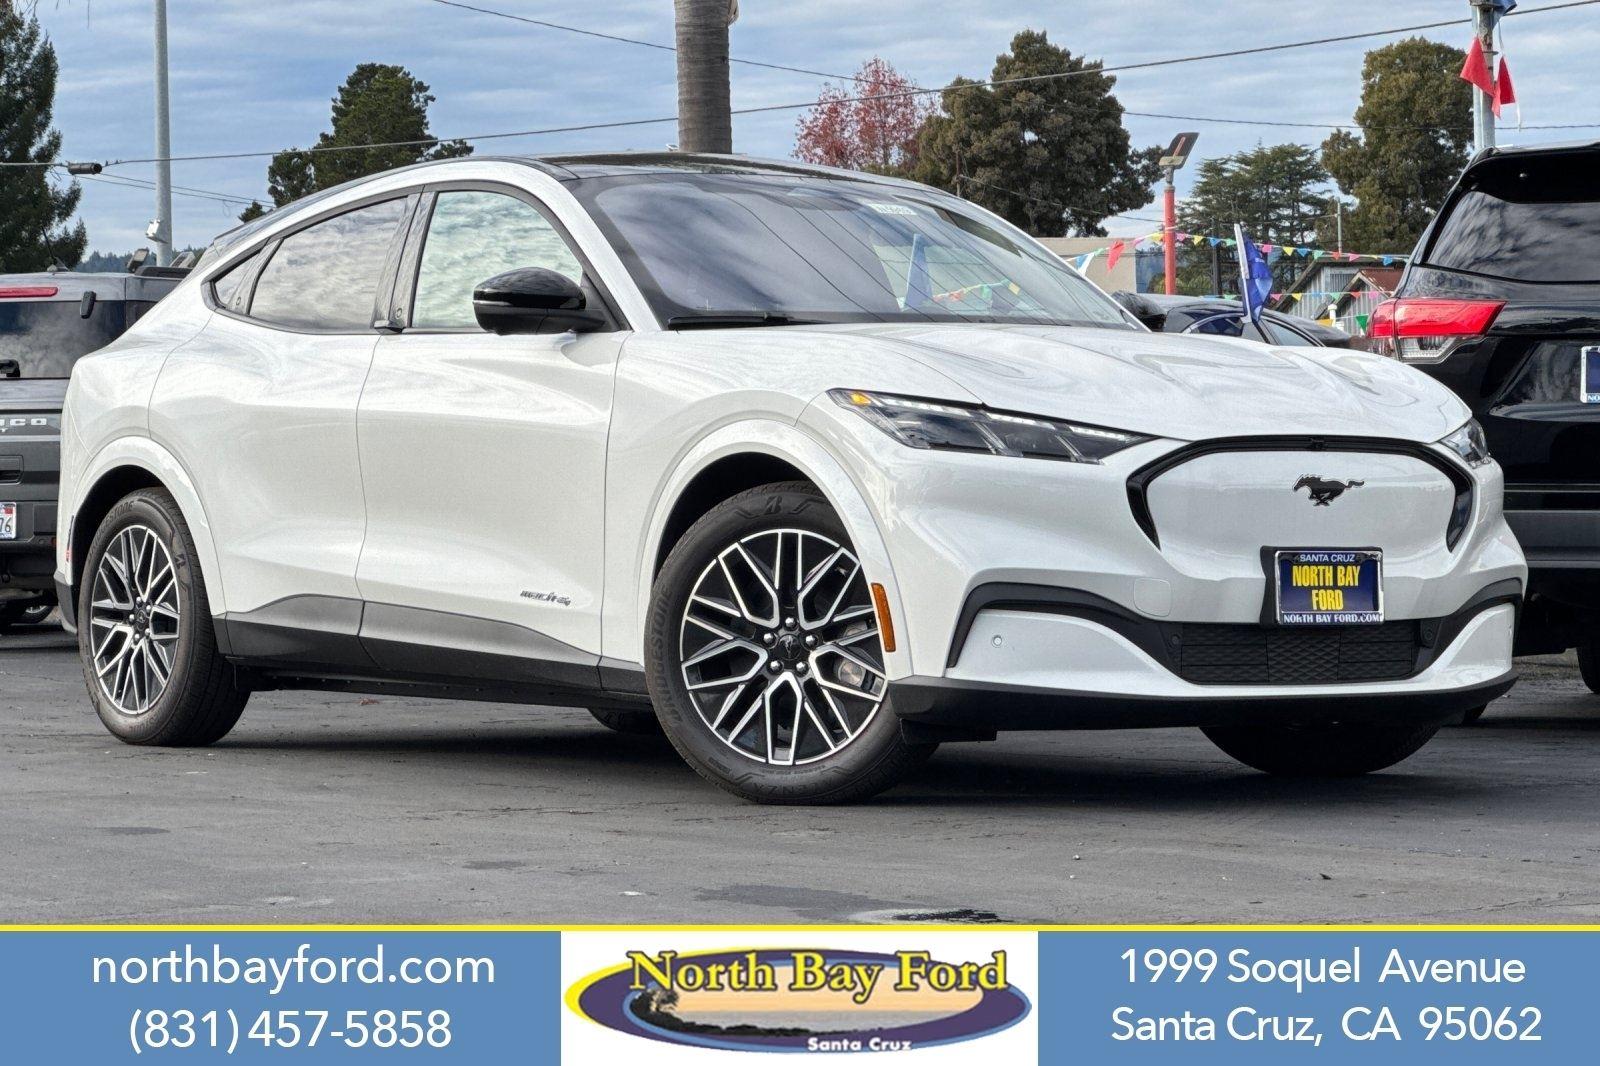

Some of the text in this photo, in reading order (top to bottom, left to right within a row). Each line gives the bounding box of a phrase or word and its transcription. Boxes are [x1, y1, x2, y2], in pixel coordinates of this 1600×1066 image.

[1300, 553, 1355, 562] SANTA CRUZ
[1292, 565, 1361, 587] NORTH BAY
[1311, 589, 1344, 611] FORD
[1284, 614, 1313, 623] NORTH
[1316, 614, 1331, 623] BAY
